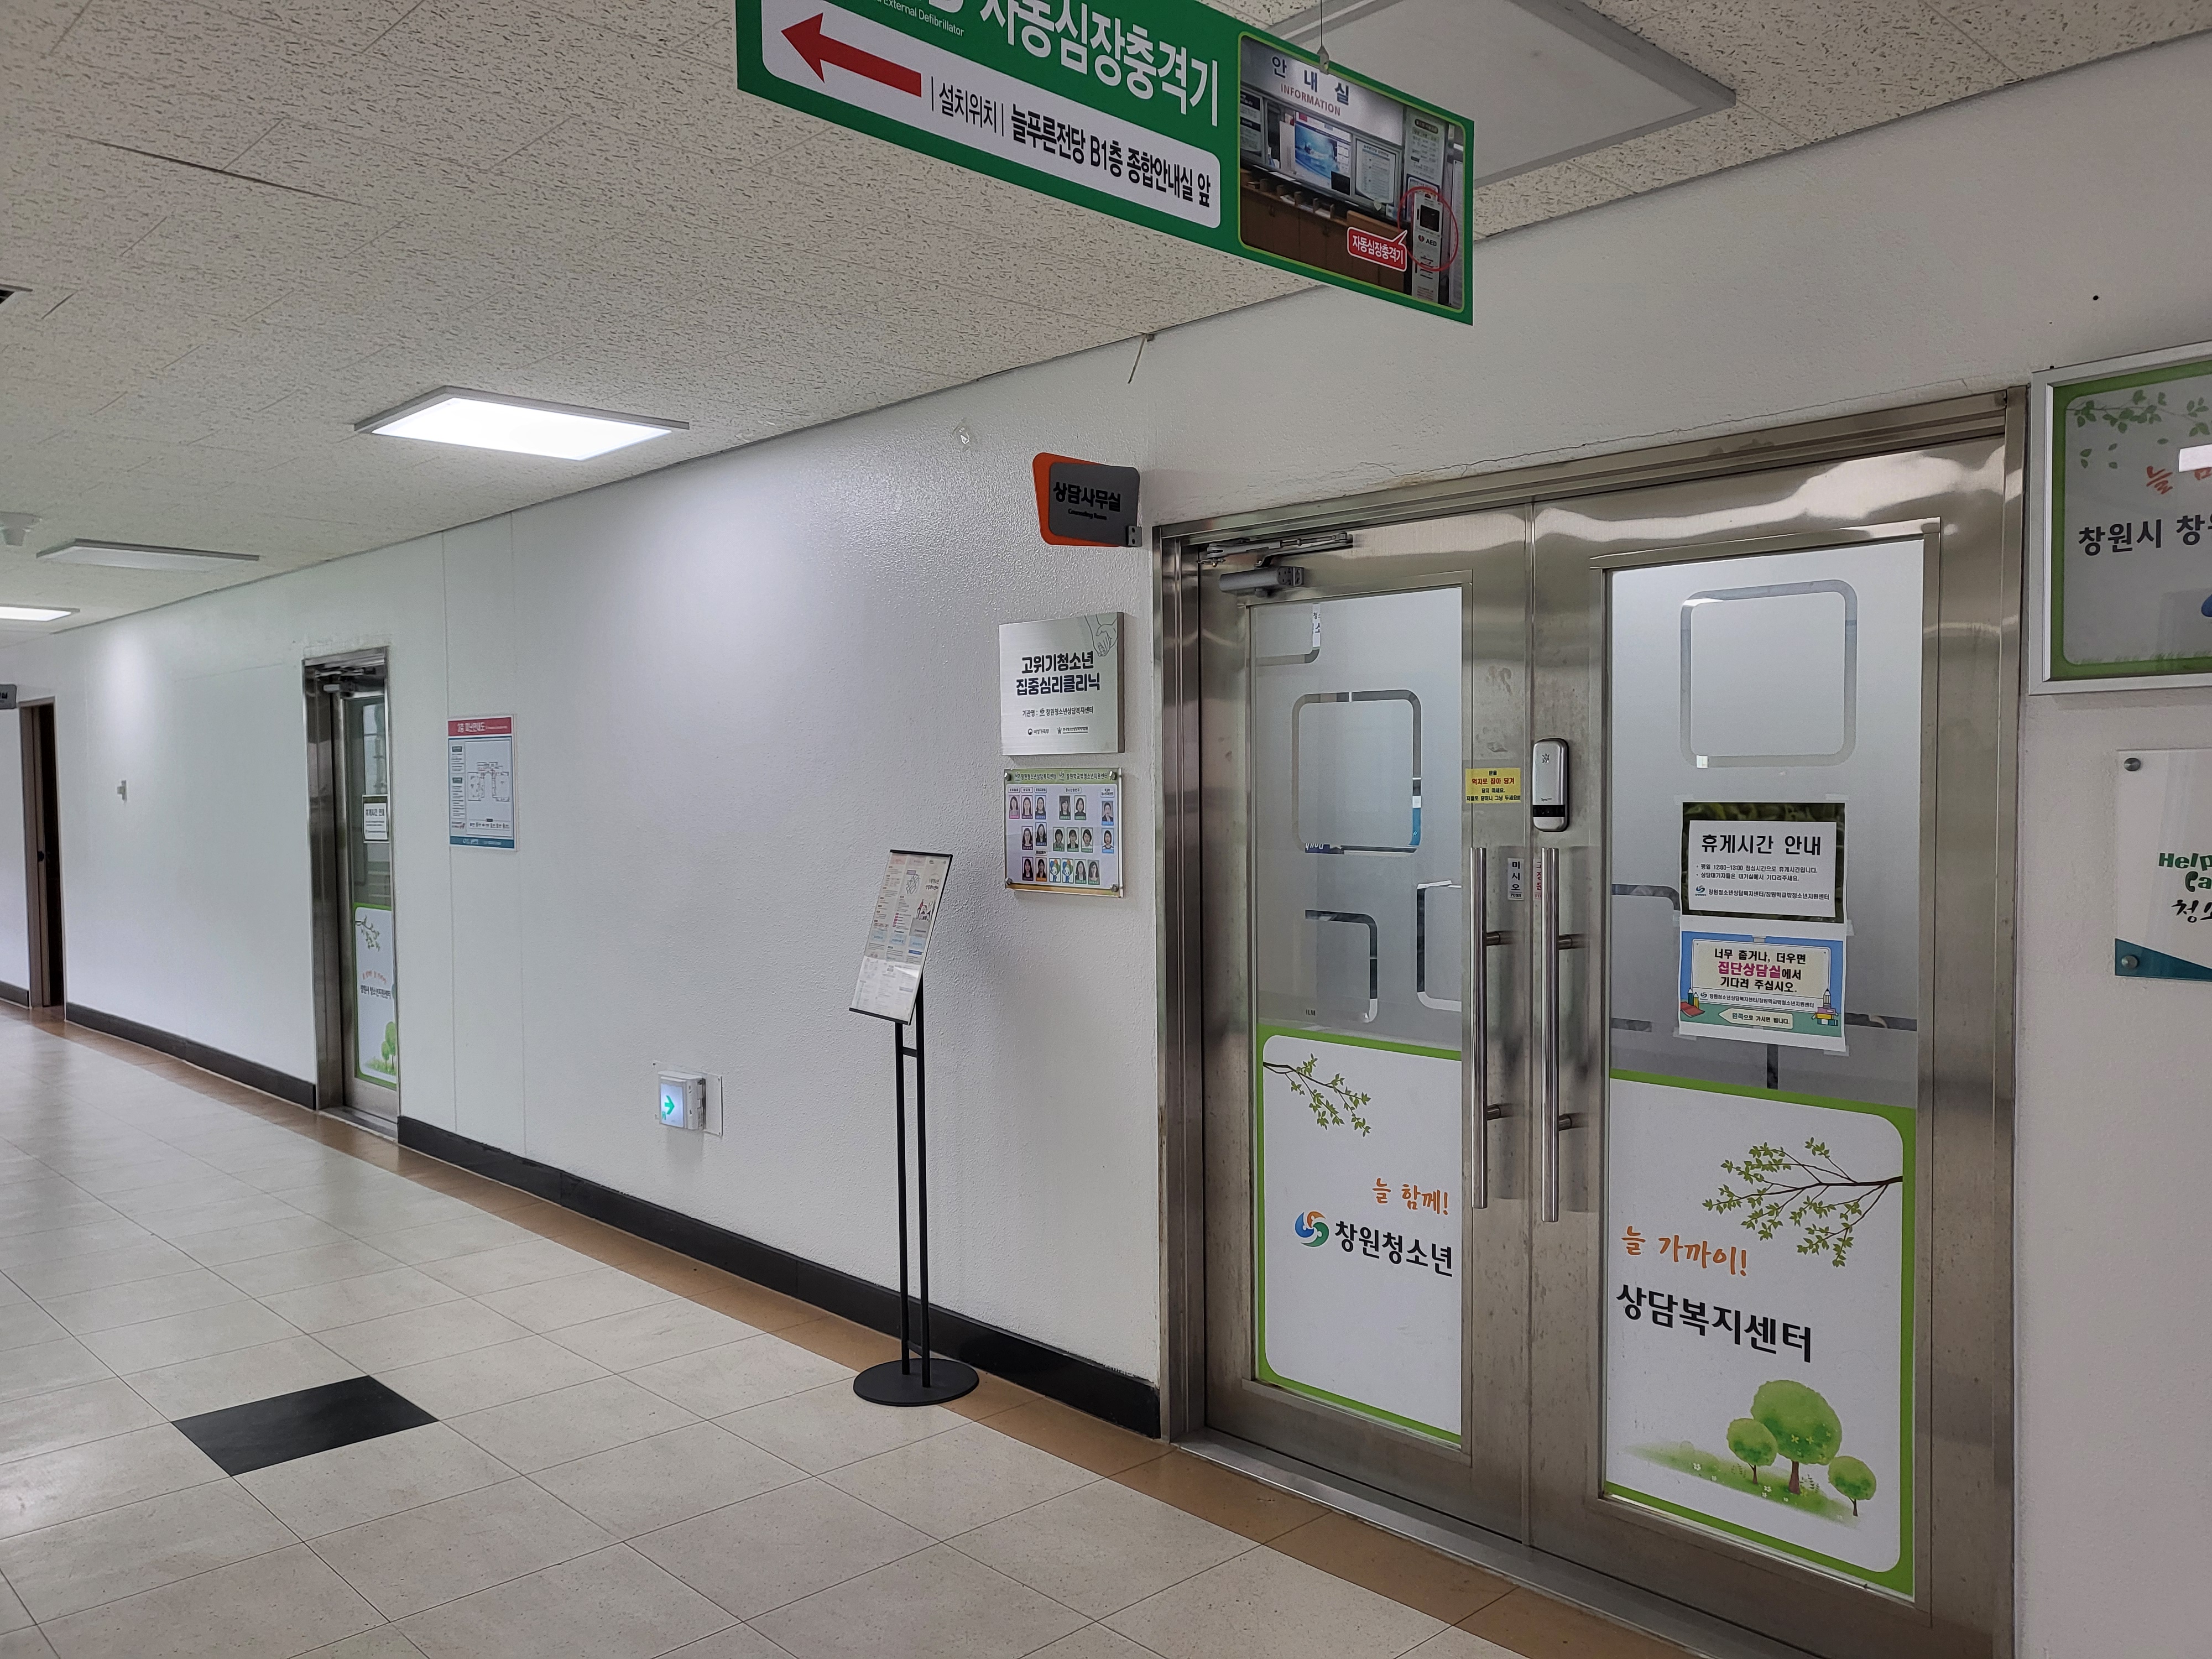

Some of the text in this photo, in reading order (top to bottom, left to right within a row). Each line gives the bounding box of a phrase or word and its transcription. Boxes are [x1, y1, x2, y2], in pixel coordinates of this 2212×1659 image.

[919, 9, 964, 36] Defibrillator
[1280, 83, 1341, 117] INFORMATION
[938, 82, 1211, 208] 설치위치 늘푸른전당 B1층 종합안내실 앞
[1352, 234, 1404, 265] 자동심장충격기
[1426, 238, 1437, 247] AED
[1053, 482, 1121, 512] 상담사무실
[2078, 514, 2212, 556] 창원시 창
[1021, 651, 1094, 674] 고위기청소년
[1016, 672, 1100, 696] 집중심리클리닉
[1701, 834, 1821, 855] 휴게시간 안내
[1714, 948, 1806, 965] 너무 춥거나, 더우면
[1718, 961, 1802, 980] 집단상담실에서
[1720, 977, 1797, 993] 기다려 주십시오.
[1372, 1177, 1449, 1215] 늘 함께!
[1334, 1220, 1453, 1278] 창원청소년
[1621, 1225, 1747, 1277] 늘 가까이!
[1616, 1284, 1811, 1363] 상담복지센터
